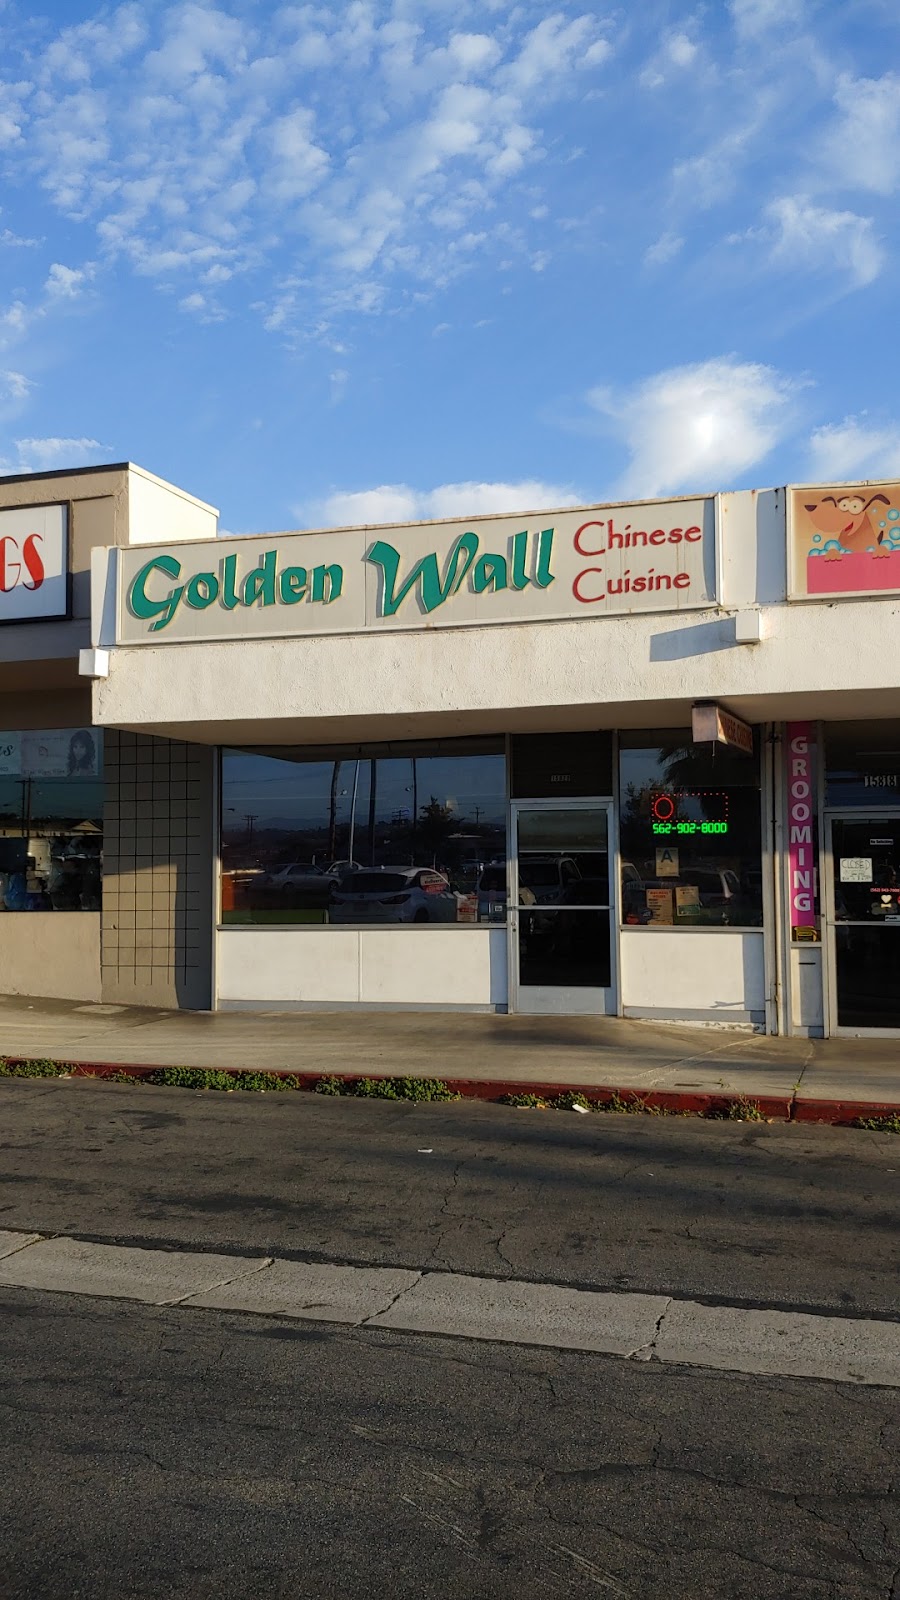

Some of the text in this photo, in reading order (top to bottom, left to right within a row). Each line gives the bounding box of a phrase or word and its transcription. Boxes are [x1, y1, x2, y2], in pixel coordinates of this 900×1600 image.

[573, 519, 702, 556] Chinese
[129, 527, 556, 632] Golden Wall
[572, 567, 691, 603] Cuisine
[865, 775, 897, 788] 15818
[652, 822, 727, 834] 562-902-8000
[790, 735, 812, 912] GROOMING
[660, 848, 674, 863] A
[841, 859, 871, 870] CLOSED
